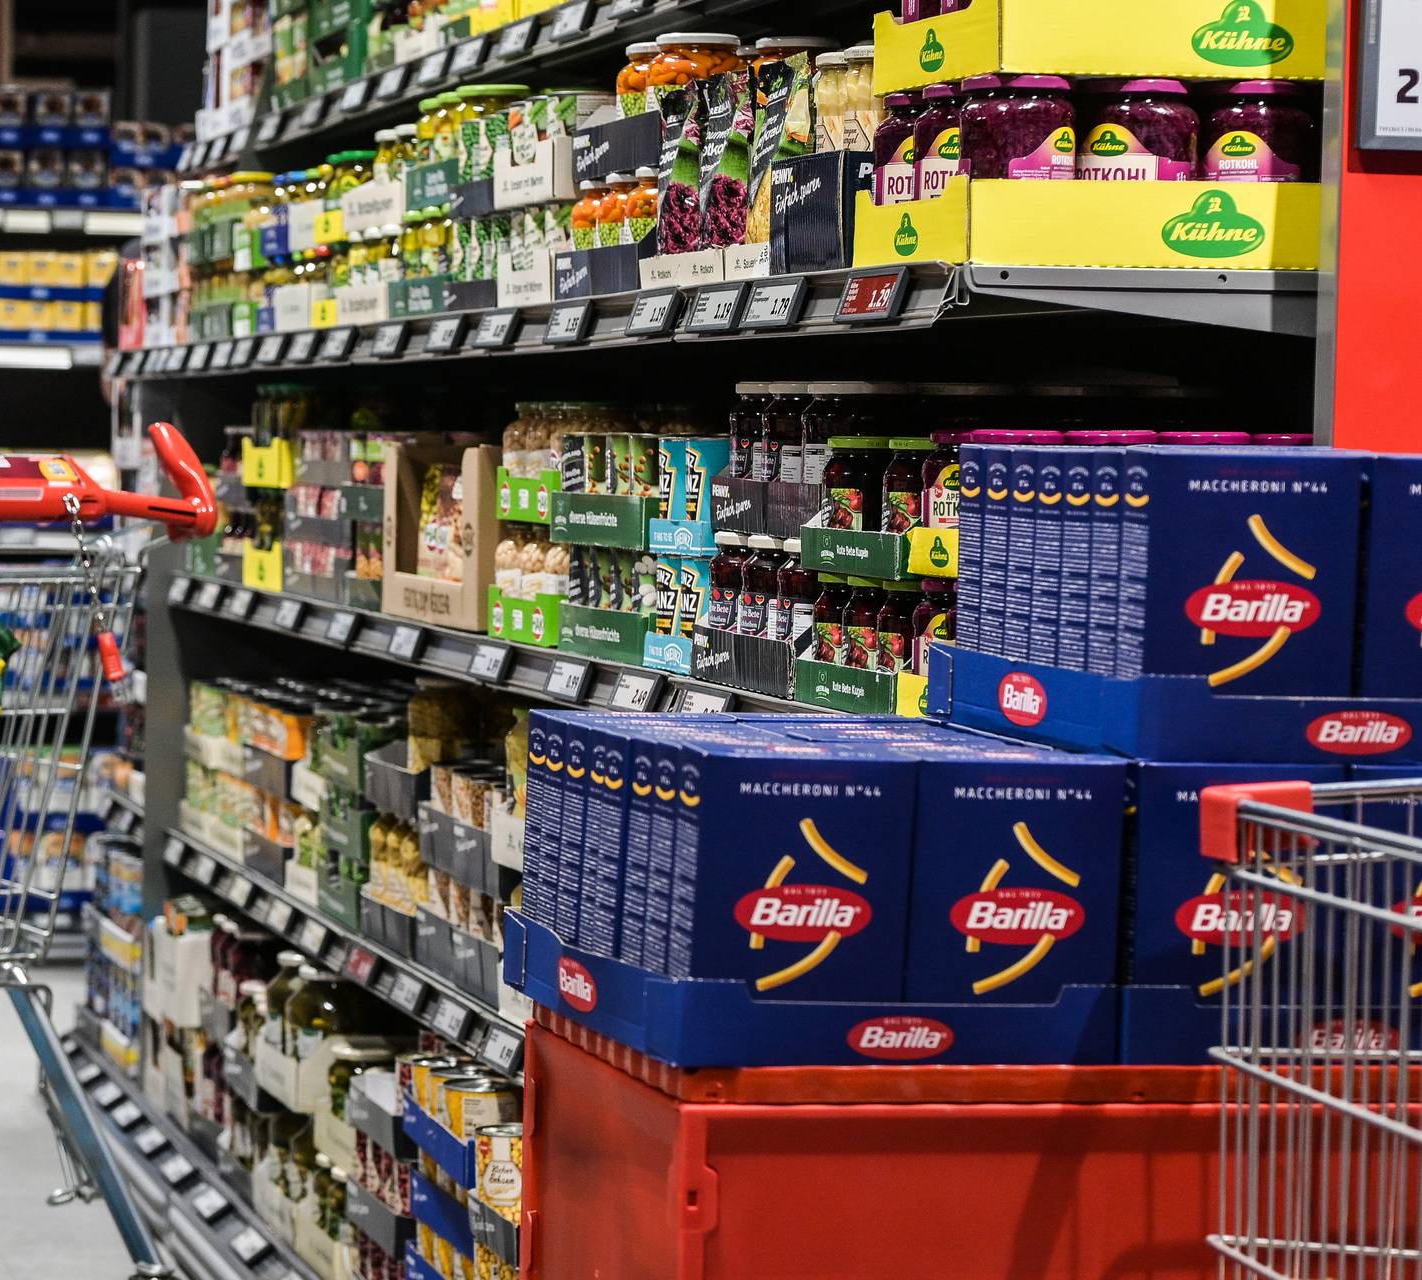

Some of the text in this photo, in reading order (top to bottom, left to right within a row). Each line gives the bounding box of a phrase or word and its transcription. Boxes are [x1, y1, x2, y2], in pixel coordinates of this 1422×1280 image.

[1200, 31, 1286, 51] Kühne
[921, 47, 944, 63] Kühne
[1092, 142, 1125, 152] Kühne
[1219, 159, 1259, 169] ROTKOHL
[896, 233, 917, 246] Kühne
[1170, 221, 1258, 242] Kühne
[770, 297, 789, 315] 1.79
[868, 288, 891, 308] 1.29
[714, 302, 732, 320] 1.19
[1189, 479, 1328, 494] MACCHERONI N°44
[946, 493, 960, 501] APF
[933, 501, 960, 516] ROTK
[716, 604, 729, 613] Bete
[748, 608, 760, 618] Bete
[1201, 593, 1305, 623] Barilla
[631, 689, 647, 706] 2.49
[1003, 683, 1041, 715] Barilla
[1318, 720, 1400, 743] Barilla
[739, 782, 882, 798] MACCHERONI N°44
[954, 787, 1092, 801] MACCHERONI N°44
[750, 897, 856, 928] Barilla
[966, 901, 1070, 931] Barilla
[559, 968, 593, 1002] Barilla
[859, 1025, 943, 1049] Barilla
